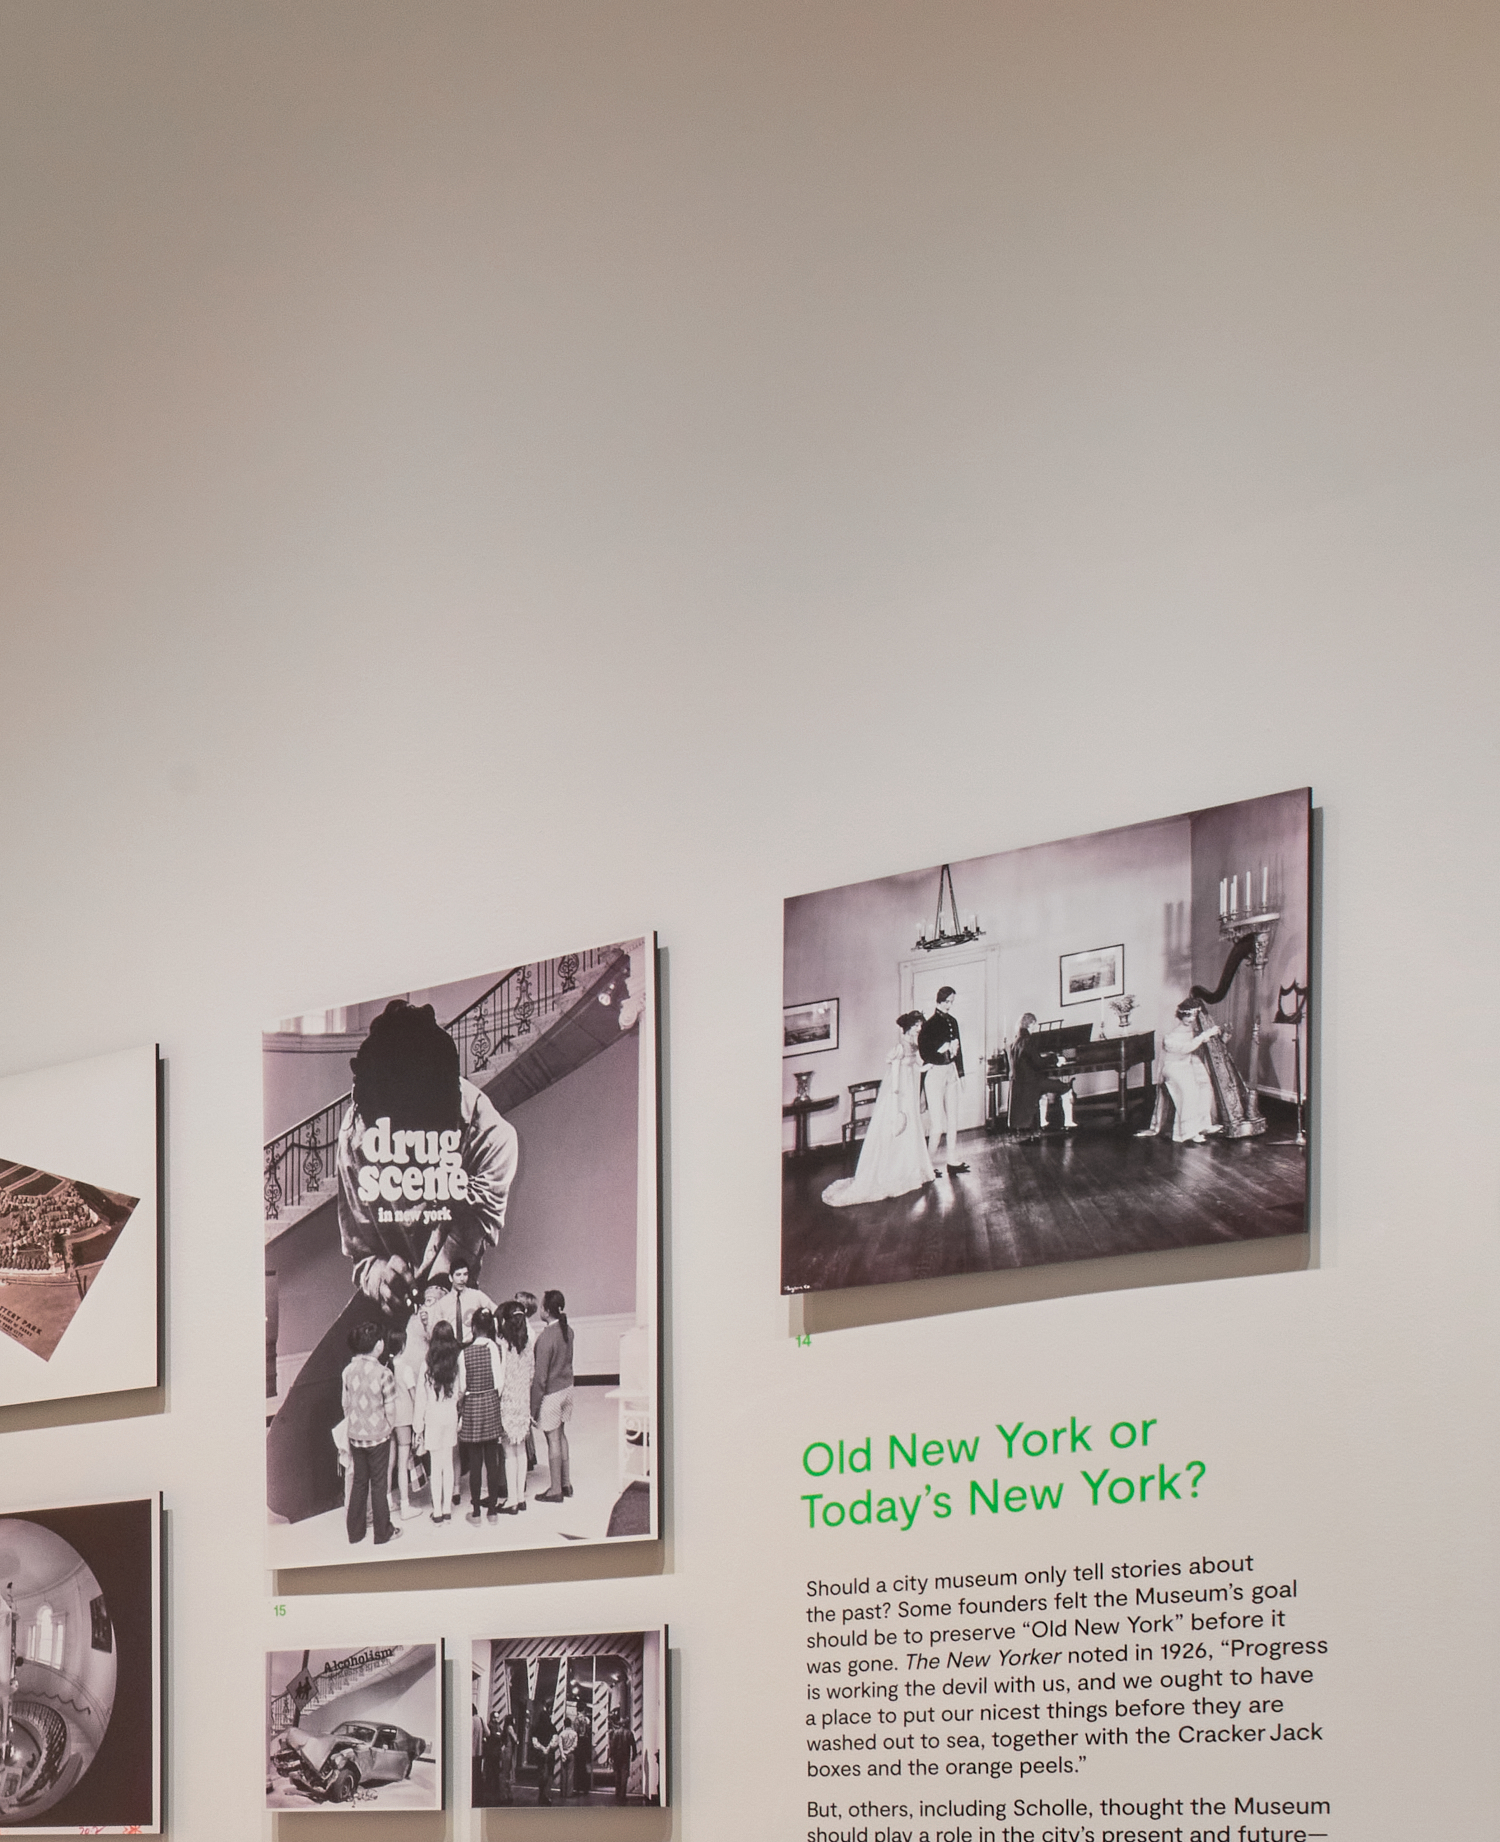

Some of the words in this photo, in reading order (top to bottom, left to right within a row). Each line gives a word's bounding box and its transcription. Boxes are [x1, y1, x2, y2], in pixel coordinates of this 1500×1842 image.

[362, 1117, 462, 1172] drug
[358, 1165, 468, 1201] scene
[378, 1207, 393, 1222] in
[423, 1206, 452, 1224] york
[796, 1335, 811, 1346] 14
[802, 1436, 872, 1477] Old
[889, 1432, 980, 1470] New
[995, 1415, 1093, 1459] York
[1109, 1418, 1158, 1449] or
[969, 1478, 1065, 1516] New
[1080, 1460, 1207, 1506] York?
[806, 1577, 870, 1597] Should
[875, 1580, 888, 1593] a
[892, 1574, 929, 1595] city
[935, 1572, 1017, 1590] museum
[1024, 1565, 1067, 1588] only
[1073, 1562, 1104, 1582] tell
[1111, 1559, 1182, 1580] stories
[1188, 1555, 1255, 1575] about
[274, 1605, 286, 1616] 15
[805, 1605, 836, 1623] the
[842, 1601, 891, 1626] past?
[897, 1600, 952, 1619] Some
[957, 1594, 1048, 1615] founders
[1053, 1591, 1088, 1610] felt
[1093, 1589, 1128, 1608] the
[1251, 1579, 1297, 1605] goal
[807, 1629, 868, 1649] should
[874, 1628, 898, 1646] be
[903, 1628, 923, 1645] to
[929, 1626, 1016, 1648] preserve
[1074, 1618, 1120, 1637] New
[1191, 1611, 1264, 1631] before
[1271, 1609, 1286, 1627] it
[324, 1647, 393, 1674] Alcoholism
[806, 1661, 842, 1675] was
[847, 1658, 898, 1677] gone.
[906, 1652, 941, 1671] The
[946, 1651, 991, 1669] New
[998, 1647, 1063, 1667] Yorker
[1068, 1643, 1128, 1664] noted
[1135, 1643, 1153, 1661] in
[1160, 1642, 1213, 1661] 1926,
